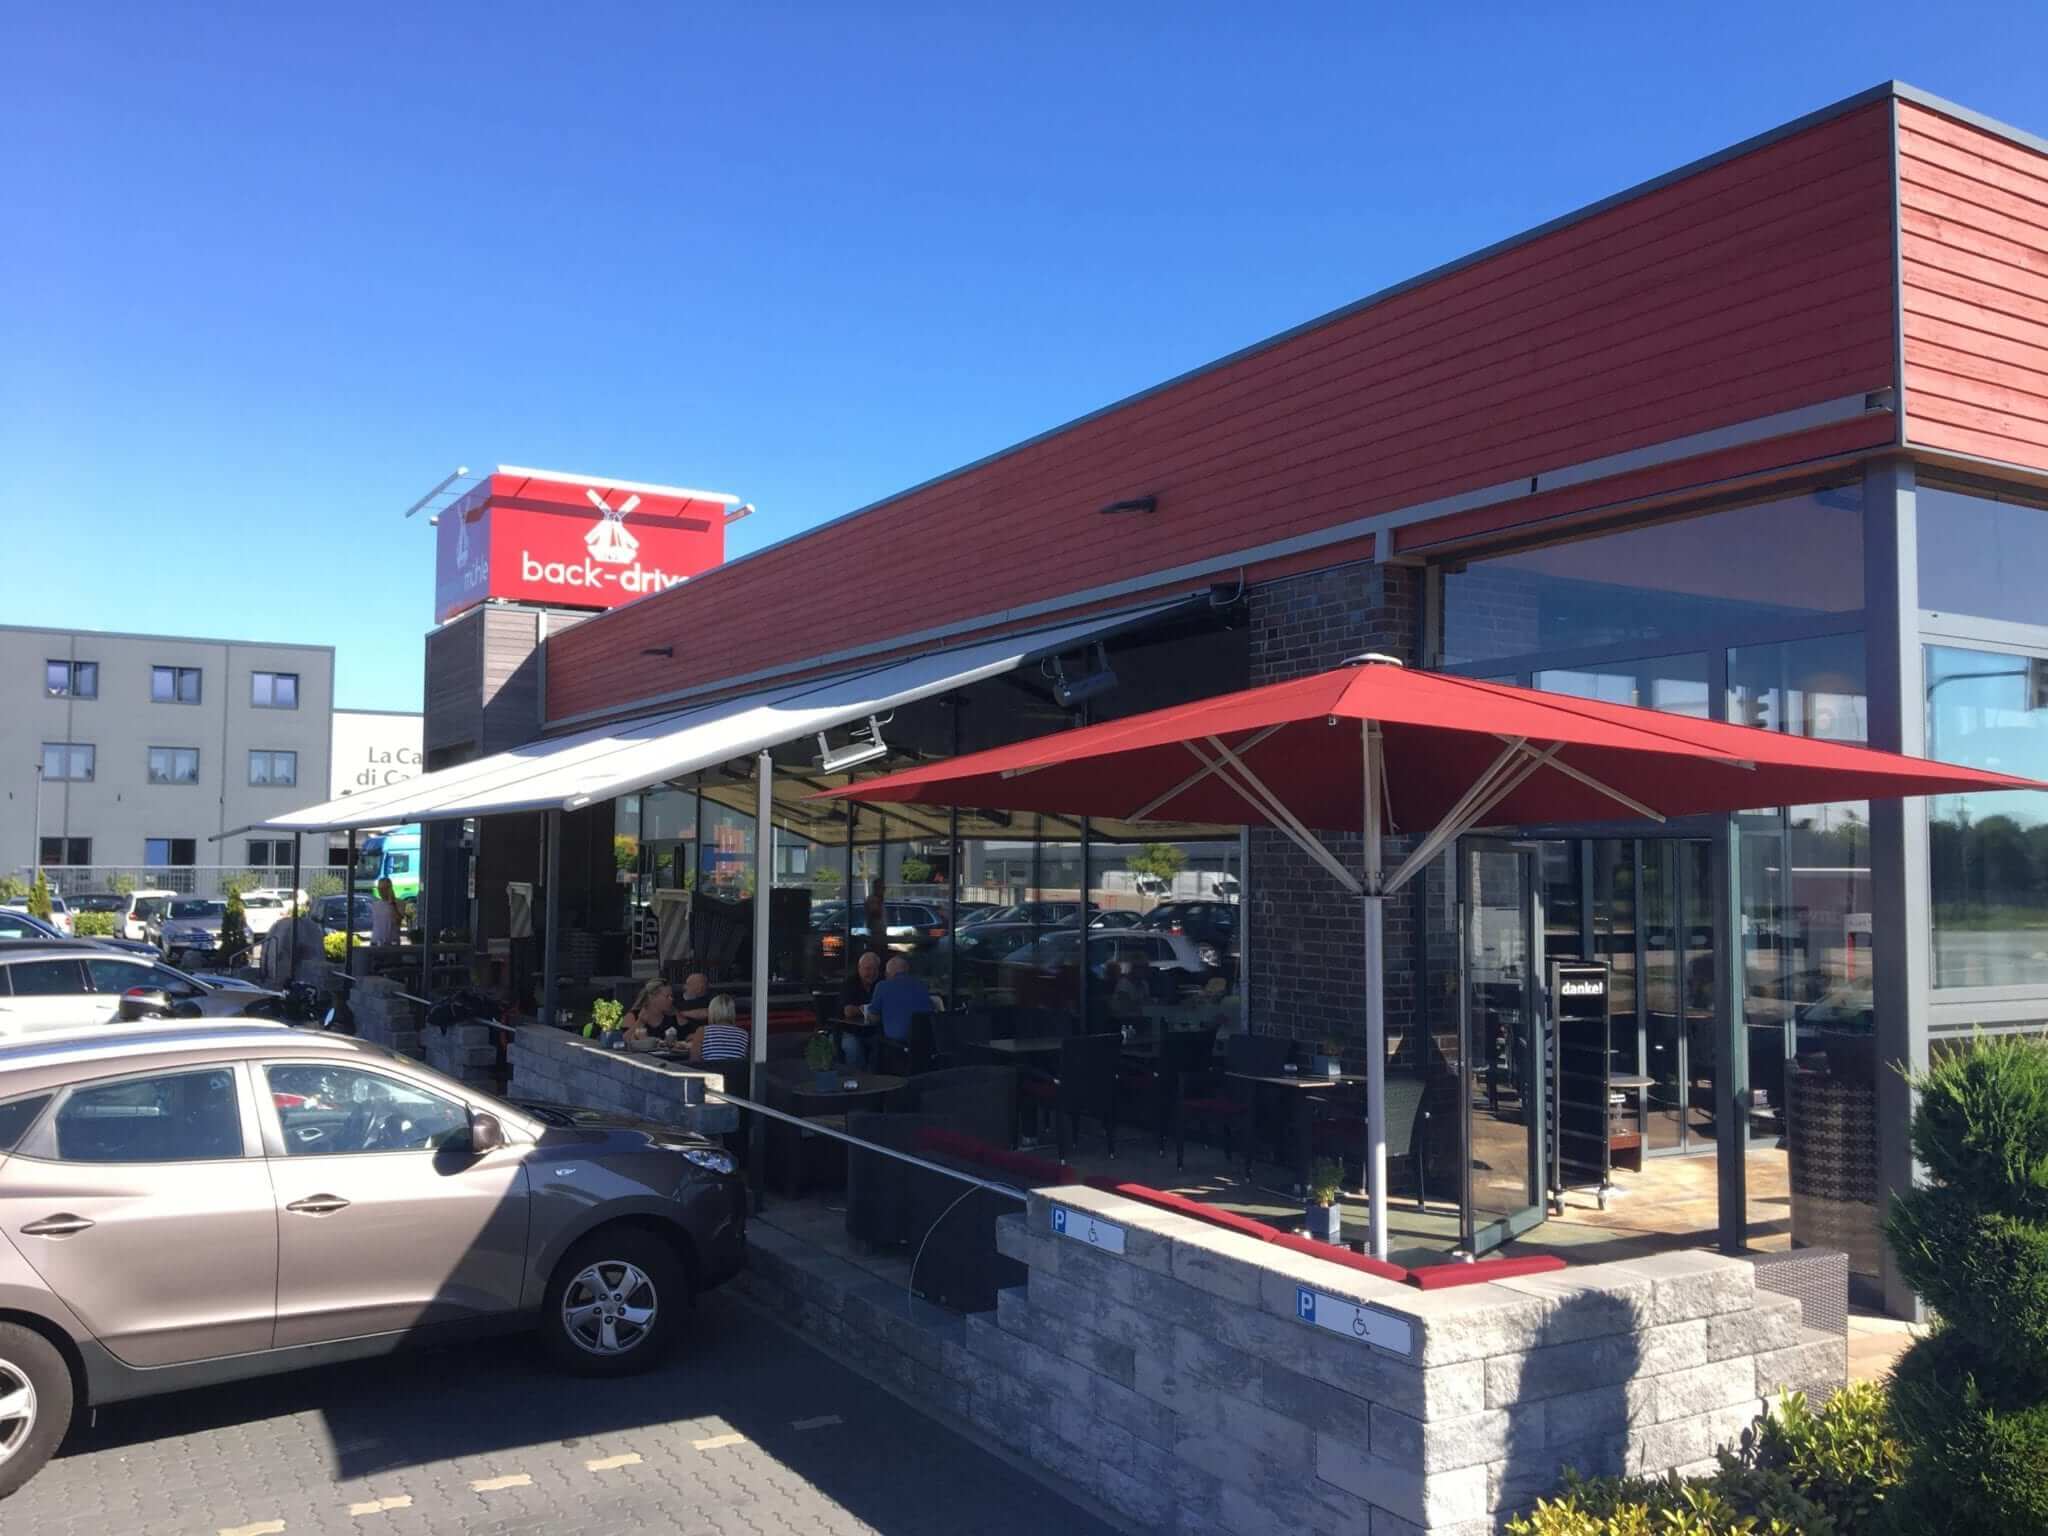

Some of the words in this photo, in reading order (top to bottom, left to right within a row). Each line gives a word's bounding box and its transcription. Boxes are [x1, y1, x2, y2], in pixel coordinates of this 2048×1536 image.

[368, 746, 392, 764] La
[356, 768, 377, 786] di
[1054, 1208, 1065, 1232] P
[1301, 1291, 1313, 1317] P
